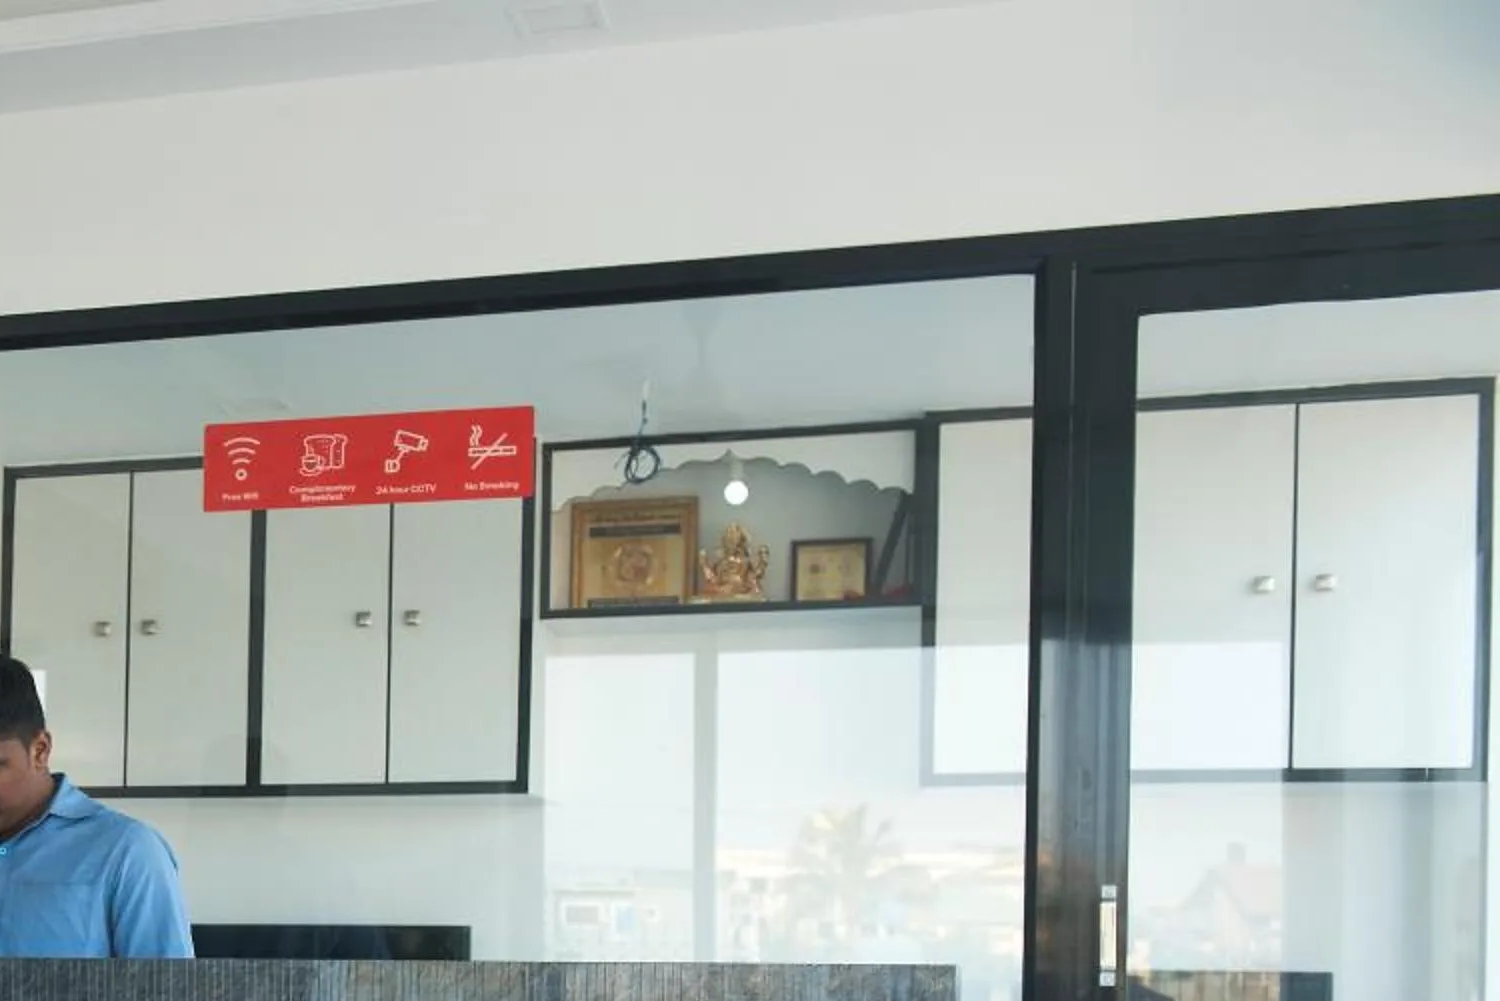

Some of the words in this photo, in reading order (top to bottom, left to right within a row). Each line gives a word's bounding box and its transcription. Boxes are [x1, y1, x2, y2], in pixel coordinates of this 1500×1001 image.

[288, 484, 357, 494] Complimentary
[410, 483, 438, 494] CCTV
[464, 481, 478, 491] No
[479, 480, 520, 492] Smoking
[300, 493, 345, 502] Breakfast
